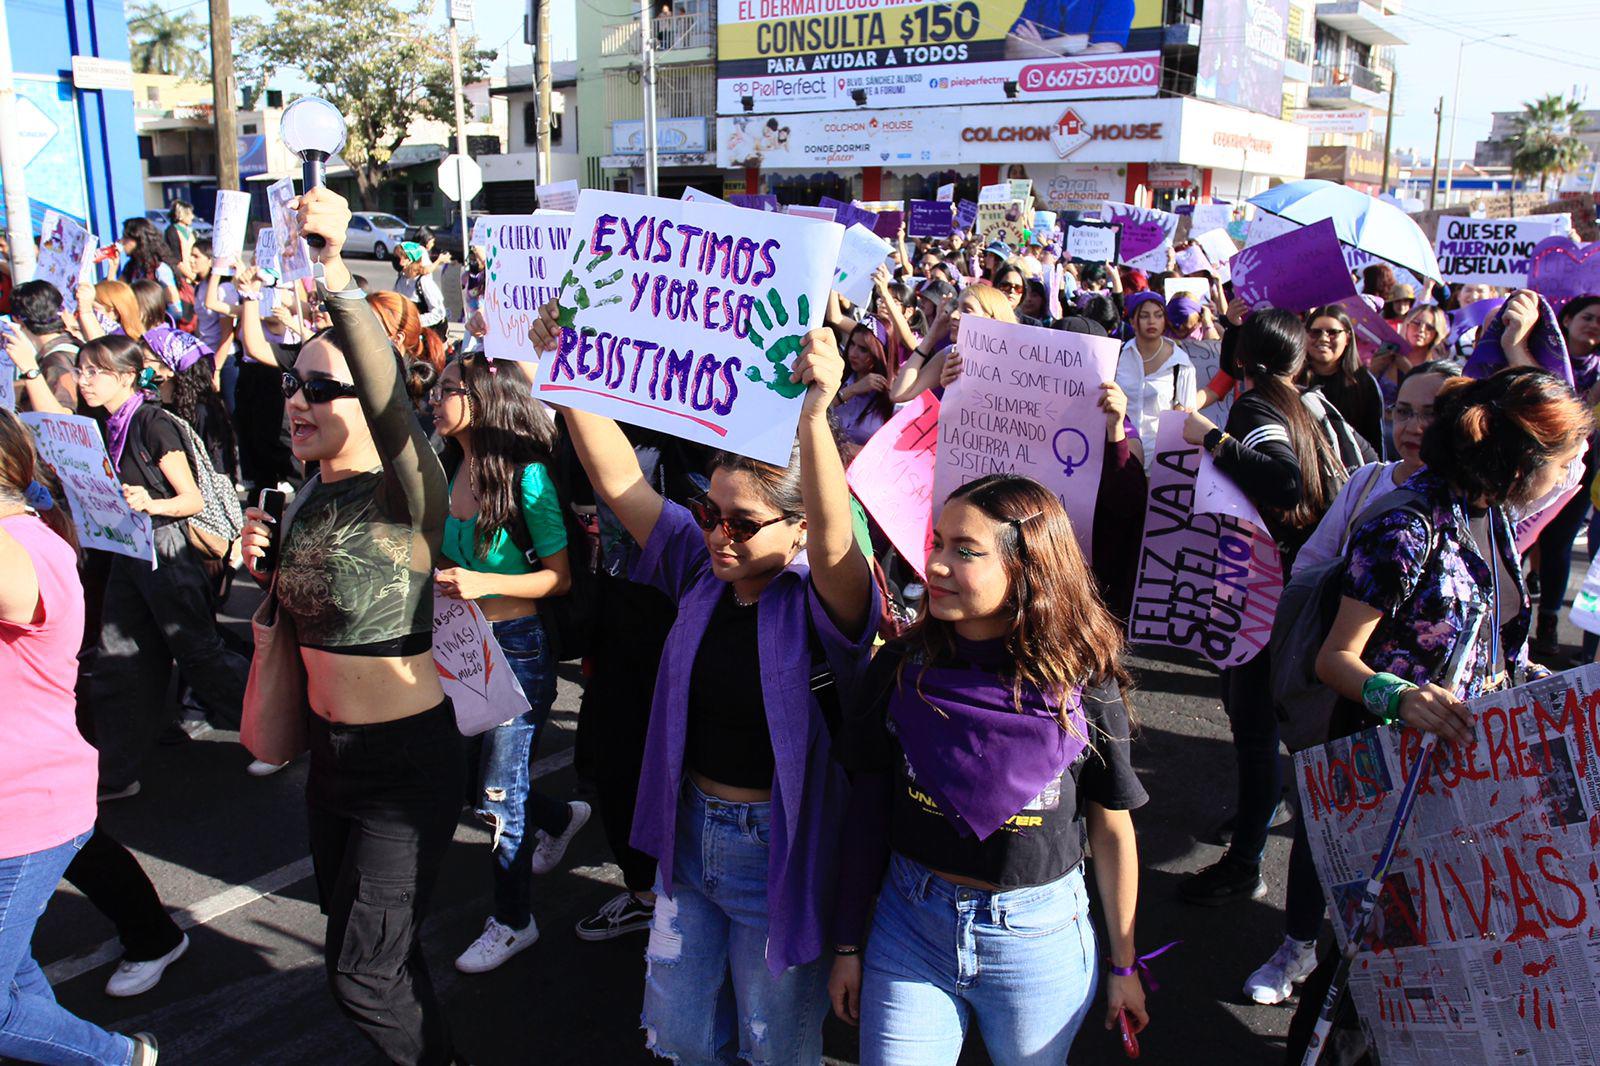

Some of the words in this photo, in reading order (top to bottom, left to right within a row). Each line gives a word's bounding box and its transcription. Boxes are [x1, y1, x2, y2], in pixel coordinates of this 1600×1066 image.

[738, 1, 755, 20] EL
[757, 12, 886, 55] CONSULTA
[900, 2, 980, 45] $150
[767, 57, 806, 74] PARA
[812, 50, 877, 70] AYUDAR
[885, 50, 898, 65] A
[904, 44, 969, 64] TODOS
[752, 76, 827, 97] PielPerfect
[896, 73, 922, 84] ALONSO
[1046, 64, 1155, 87] 6675730700
[824, 123, 866, 133] COLCHON
[883, 120, 913, 130] HOUSE
[961, 126, 1051, 143] COLCHON
[1091, 122, 1163, 141] HOUSE
[804, 144, 834, 153] DONDE
[837, 143, 871, 152] DORMIR
[1049, 189, 1110, 200] Colchoniza
[1448, 221, 1481, 240] QUE
[1482, 223, 1517, 240] SER
[589, 213, 781, 288] EXISTIMOS
[1439, 240, 1485, 256] MUJER
[1485, 241, 1510, 256] NO
[528, 255, 547, 280] NO
[1437, 256, 1487, 276] CUESTE
[1487, 257, 1509, 275] LA
[629, 271, 650, 313] Y
[650, 273, 699, 322] POR
[703, 285, 756, 340] ESO
[964, 329, 1008, 356] NUNCA
[1018, 342, 1083, 368] CALLADA
[549, 325, 743, 416] RESISTIMOS
[1008, 368, 1086, 398] SOMETIDA
[981, 393, 1042, 419] SIEMPRE
[960, 407, 1047, 442] DECLARANDO
[943, 423, 960, 446] LA
[962, 430, 1010, 459] GUERRA
[1015, 443, 1038, 465] AL
[1155, 447, 1200, 478] A
[1145, 483, 1193, 539] VA
[1176, 546, 1218, 580] EL
[1215, 535, 1251, 594] NO
[1131, 546, 1180, 641] FELIZ
[1166, 580, 1216, 646] SER
[1202, 592, 1245, 662] QUE
[1304, 742, 1386, 821] NOS
[1376, 846, 1588, 947] VIVAS
